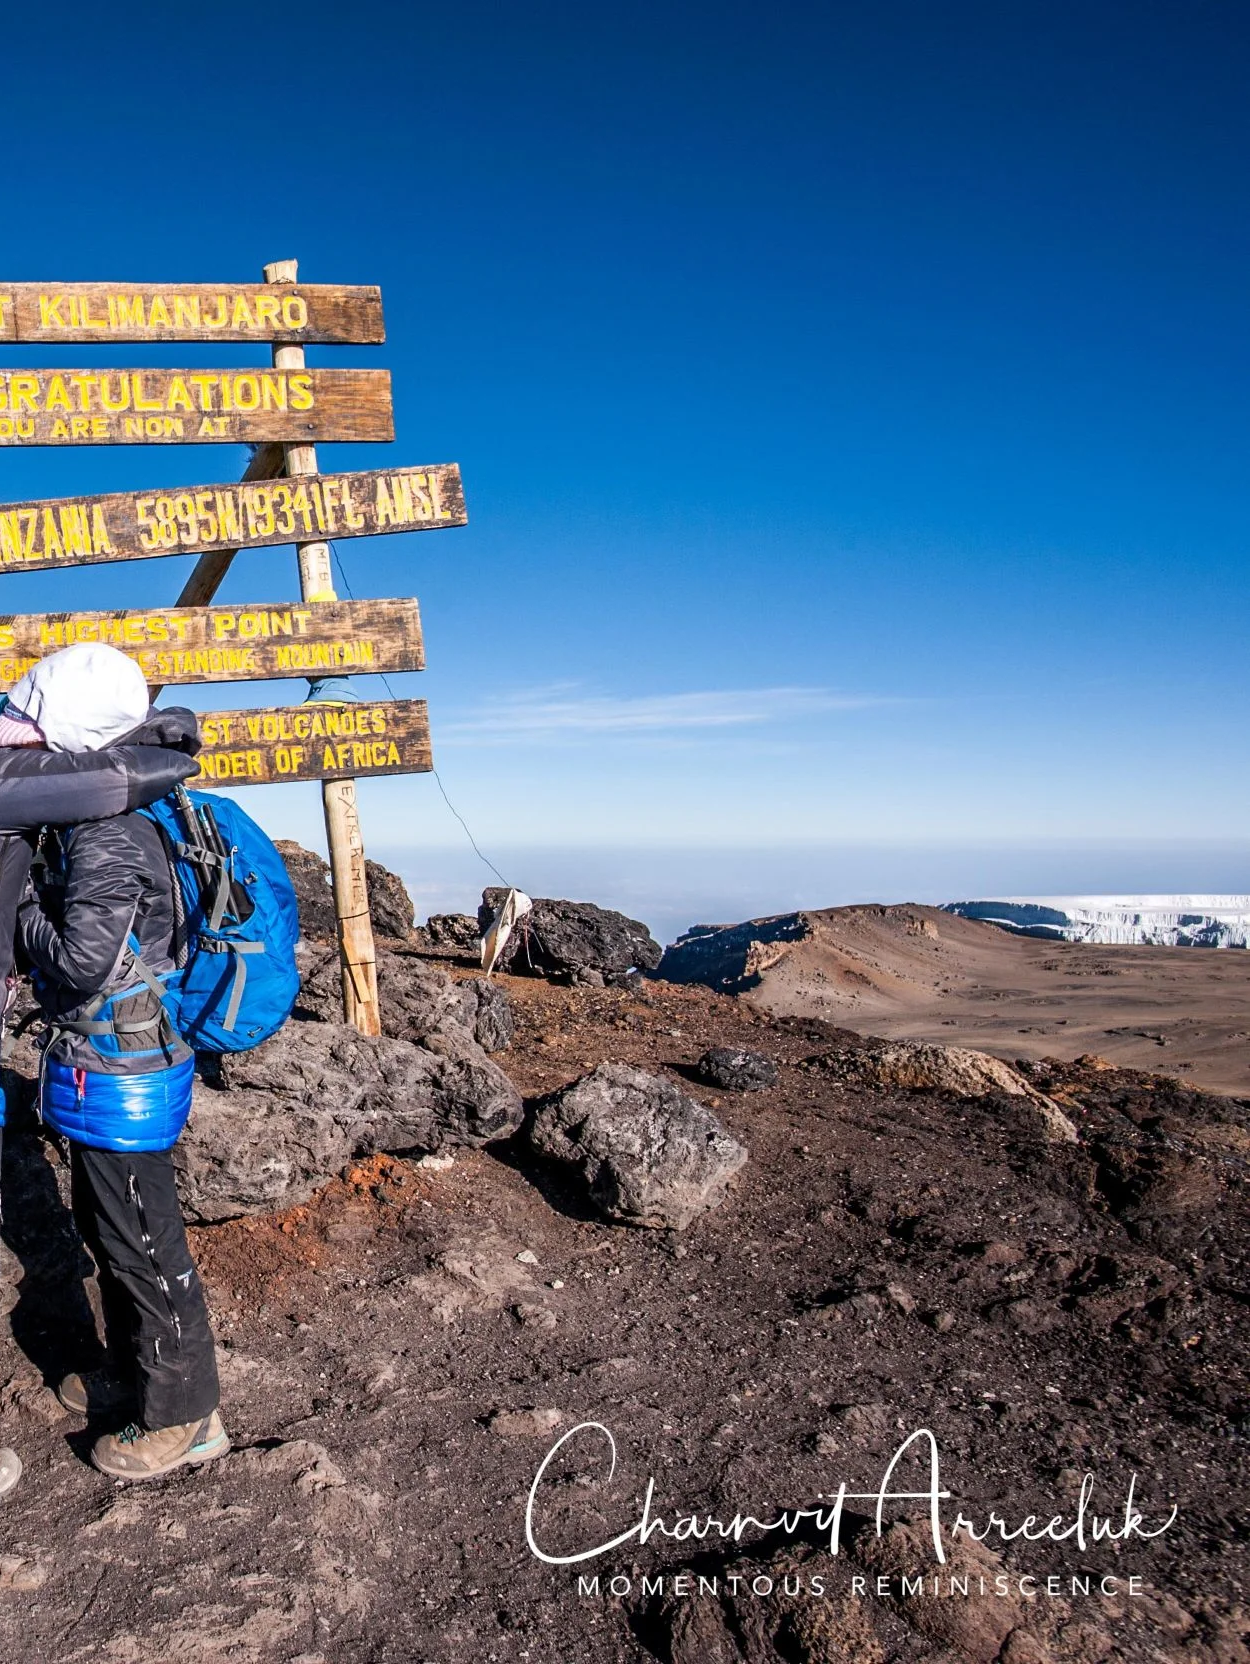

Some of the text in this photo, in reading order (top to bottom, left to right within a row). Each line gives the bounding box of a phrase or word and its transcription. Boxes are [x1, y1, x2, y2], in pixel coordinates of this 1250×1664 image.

[40, 293, 308, 330] KILIMANJARO
[50, 416, 111, 438] ARE
[124, 416, 184, 438] NOW
[197, 416, 231, 438] AT
[375, 472, 452, 526] AMSL
[39, 616, 192, 645] HIGHEST
[213, 610, 312, 640] POINT
[277, 640, 374, 670] MOUNTAIN
[246, 708, 387, 743] VOLCANOES
[184, 740, 402, 781] NDER OF AFRICA
